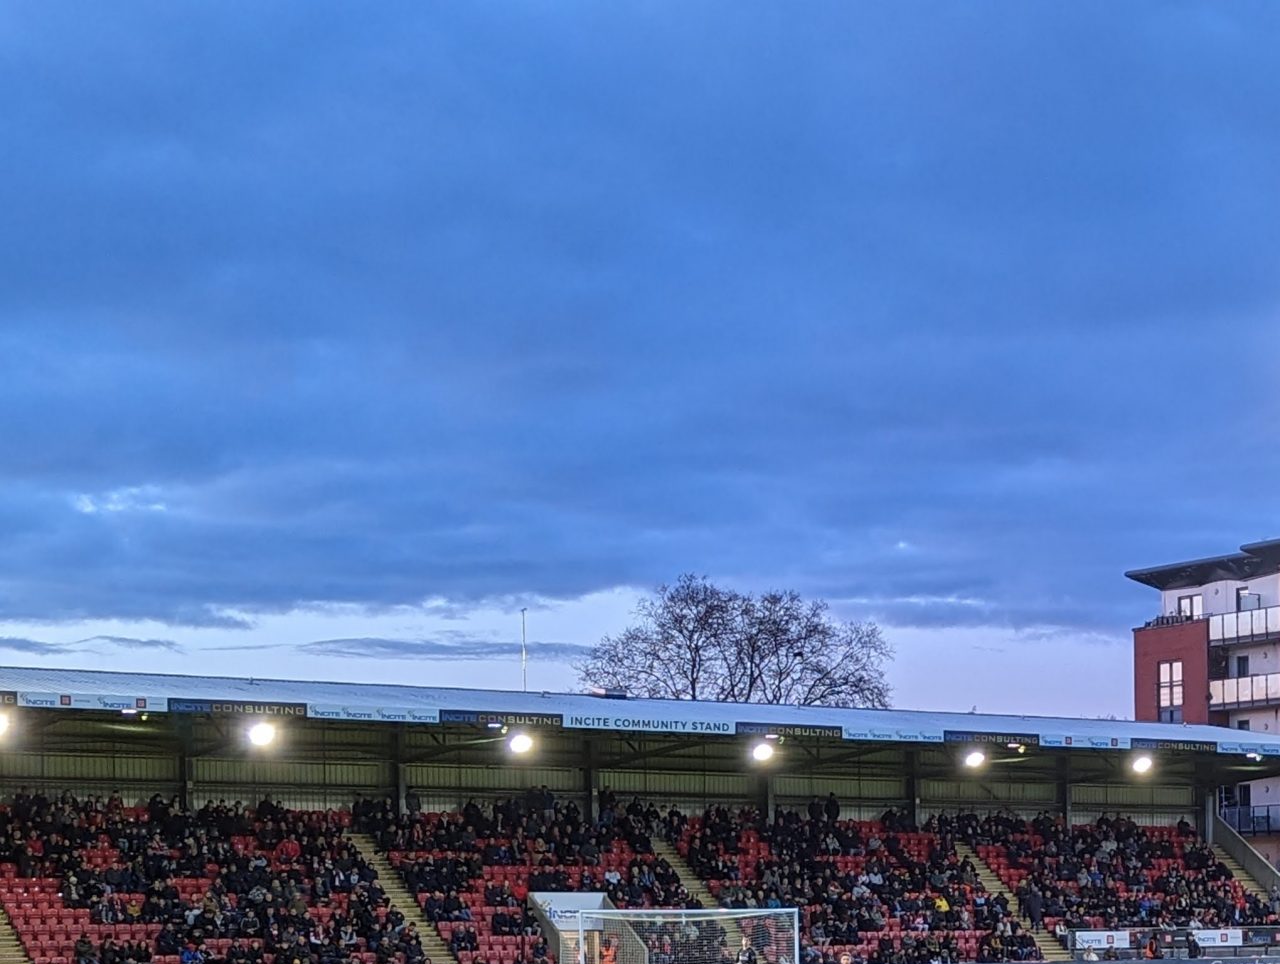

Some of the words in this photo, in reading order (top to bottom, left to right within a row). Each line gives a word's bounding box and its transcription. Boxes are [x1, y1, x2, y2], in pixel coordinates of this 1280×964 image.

[212, 704, 305, 716] CONSULTING
[479, 714, 560, 725] CONSULTING
[570, 716, 610, 728] INCITE
[614, 719, 688, 731] COMMUNITY
[691, 721, 730, 732] STAND
[768, 726, 841, 737] CONSULTING
[974, 734, 1038, 745] CONSULTING
[1158, 741, 1215, 752] CONSULTING
